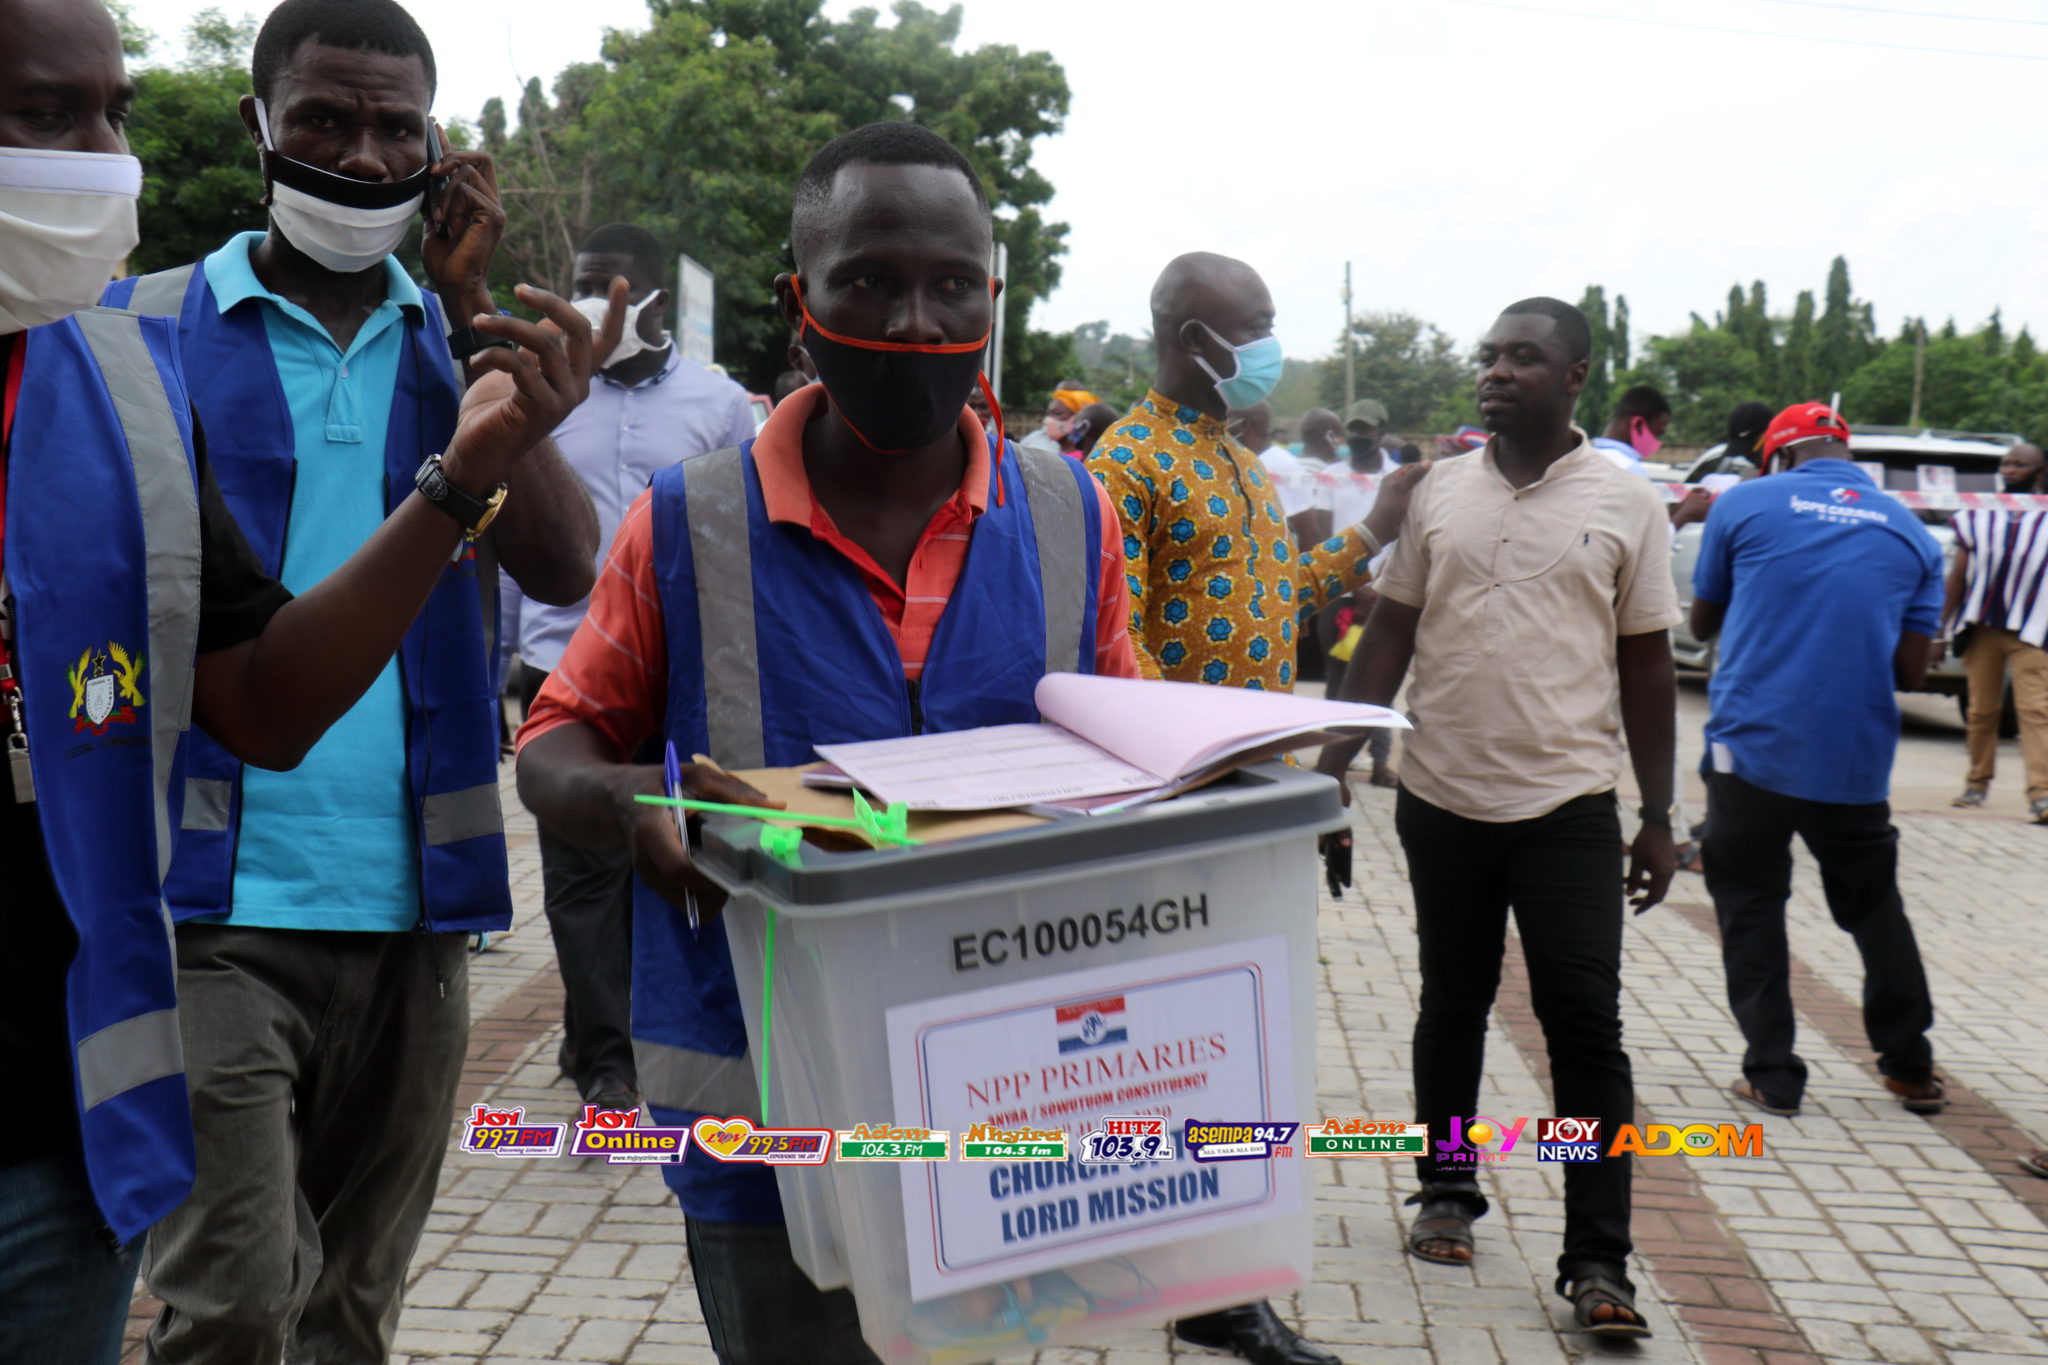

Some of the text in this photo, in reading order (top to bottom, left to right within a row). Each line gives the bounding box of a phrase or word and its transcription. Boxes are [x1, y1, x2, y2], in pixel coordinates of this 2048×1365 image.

[953, 893, 1210, 972] EC100054GH
[965, 1032, 1227, 1110] NPP PRIMARIES
[1116, 1072, 1208, 1104] CONSTITUENCY
[1001, 1165, 1220, 1245] LORD MISSION
